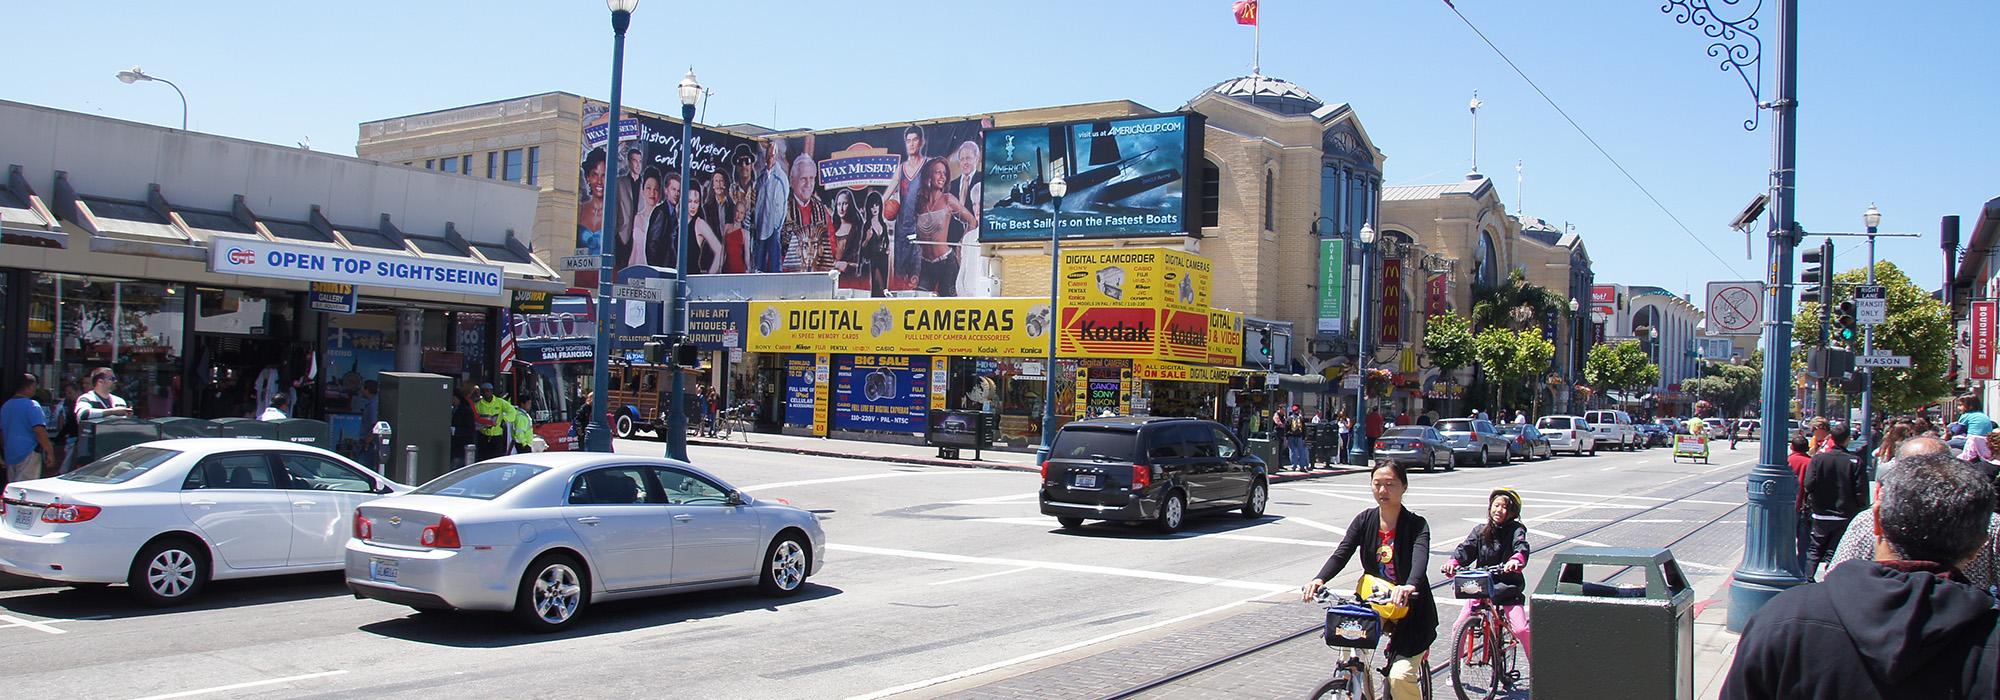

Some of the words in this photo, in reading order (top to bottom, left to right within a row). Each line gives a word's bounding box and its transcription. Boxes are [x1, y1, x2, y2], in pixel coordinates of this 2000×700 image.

[587, 128, 605, 140] WAX
[1078, 130, 1090, 138] visit
[690, 136, 731, 162] Mystery
[655, 149, 678, 168] and
[682, 154, 716, 173] ovies
[821, 166, 847, 178] WAX
[848, 163, 897, 174] MUSEUM
[990, 220, 1007, 230] The
[1009, 219, 1031, 230] Best
[1070, 220, 1084, 228] on
[1085, 216, 1102, 226] the
[1105, 215, 1143, 226] Fastest
[1146, 214, 1178, 224] Boats
[567, 259, 593, 268] MASON
[1066, 255, 1098, 264] DIGITAL
[1100, 254, 1155, 264] CAMCORDER
[1164, 254, 1185, 267] DIGITAL
[1186, 258, 1210, 272] CAMERAS
[268, 250, 325, 271] OPEN
[332, 256, 372, 275] TOP
[377, 261, 498, 287] SIGHTSEEING
[319, 294, 344, 303] GALLERY
[515, 290, 546, 302] SUBWAY
[616, 288, 657, 300] JEFFERSON
[690, 309, 710, 318] FINE
[712, 309, 730, 318] ART
[789, 310, 862, 330] DIGITAL
[903, 309, 1014, 332] CAMERAS
[1979, 306, 1987, 336] BOUDIN
[1081, 320, 1150, 342] Kodak
[1170, 322, 1208, 346] Kodak
[968, 334, 1010, 342] ACCESSORIES
[1213, 330, 1218, 342] &
[1221, 331, 1240, 346] VIDEO
[978, 346, 998, 354] Kodak
[1979, 339, 1987, 359] CAFE
[542, 352, 557, 360] SAN
[559, 351, 593, 359] FRANCISCO
[854, 356, 875, 366] BIG
[879, 357, 909, 366] SALE
[1092, 370, 1117, 378] SALE
[1161, 371, 1186, 379] SALE
[1190, 368, 1208, 379] DIGITAL
[851, 414, 875, 422] 110-220V
